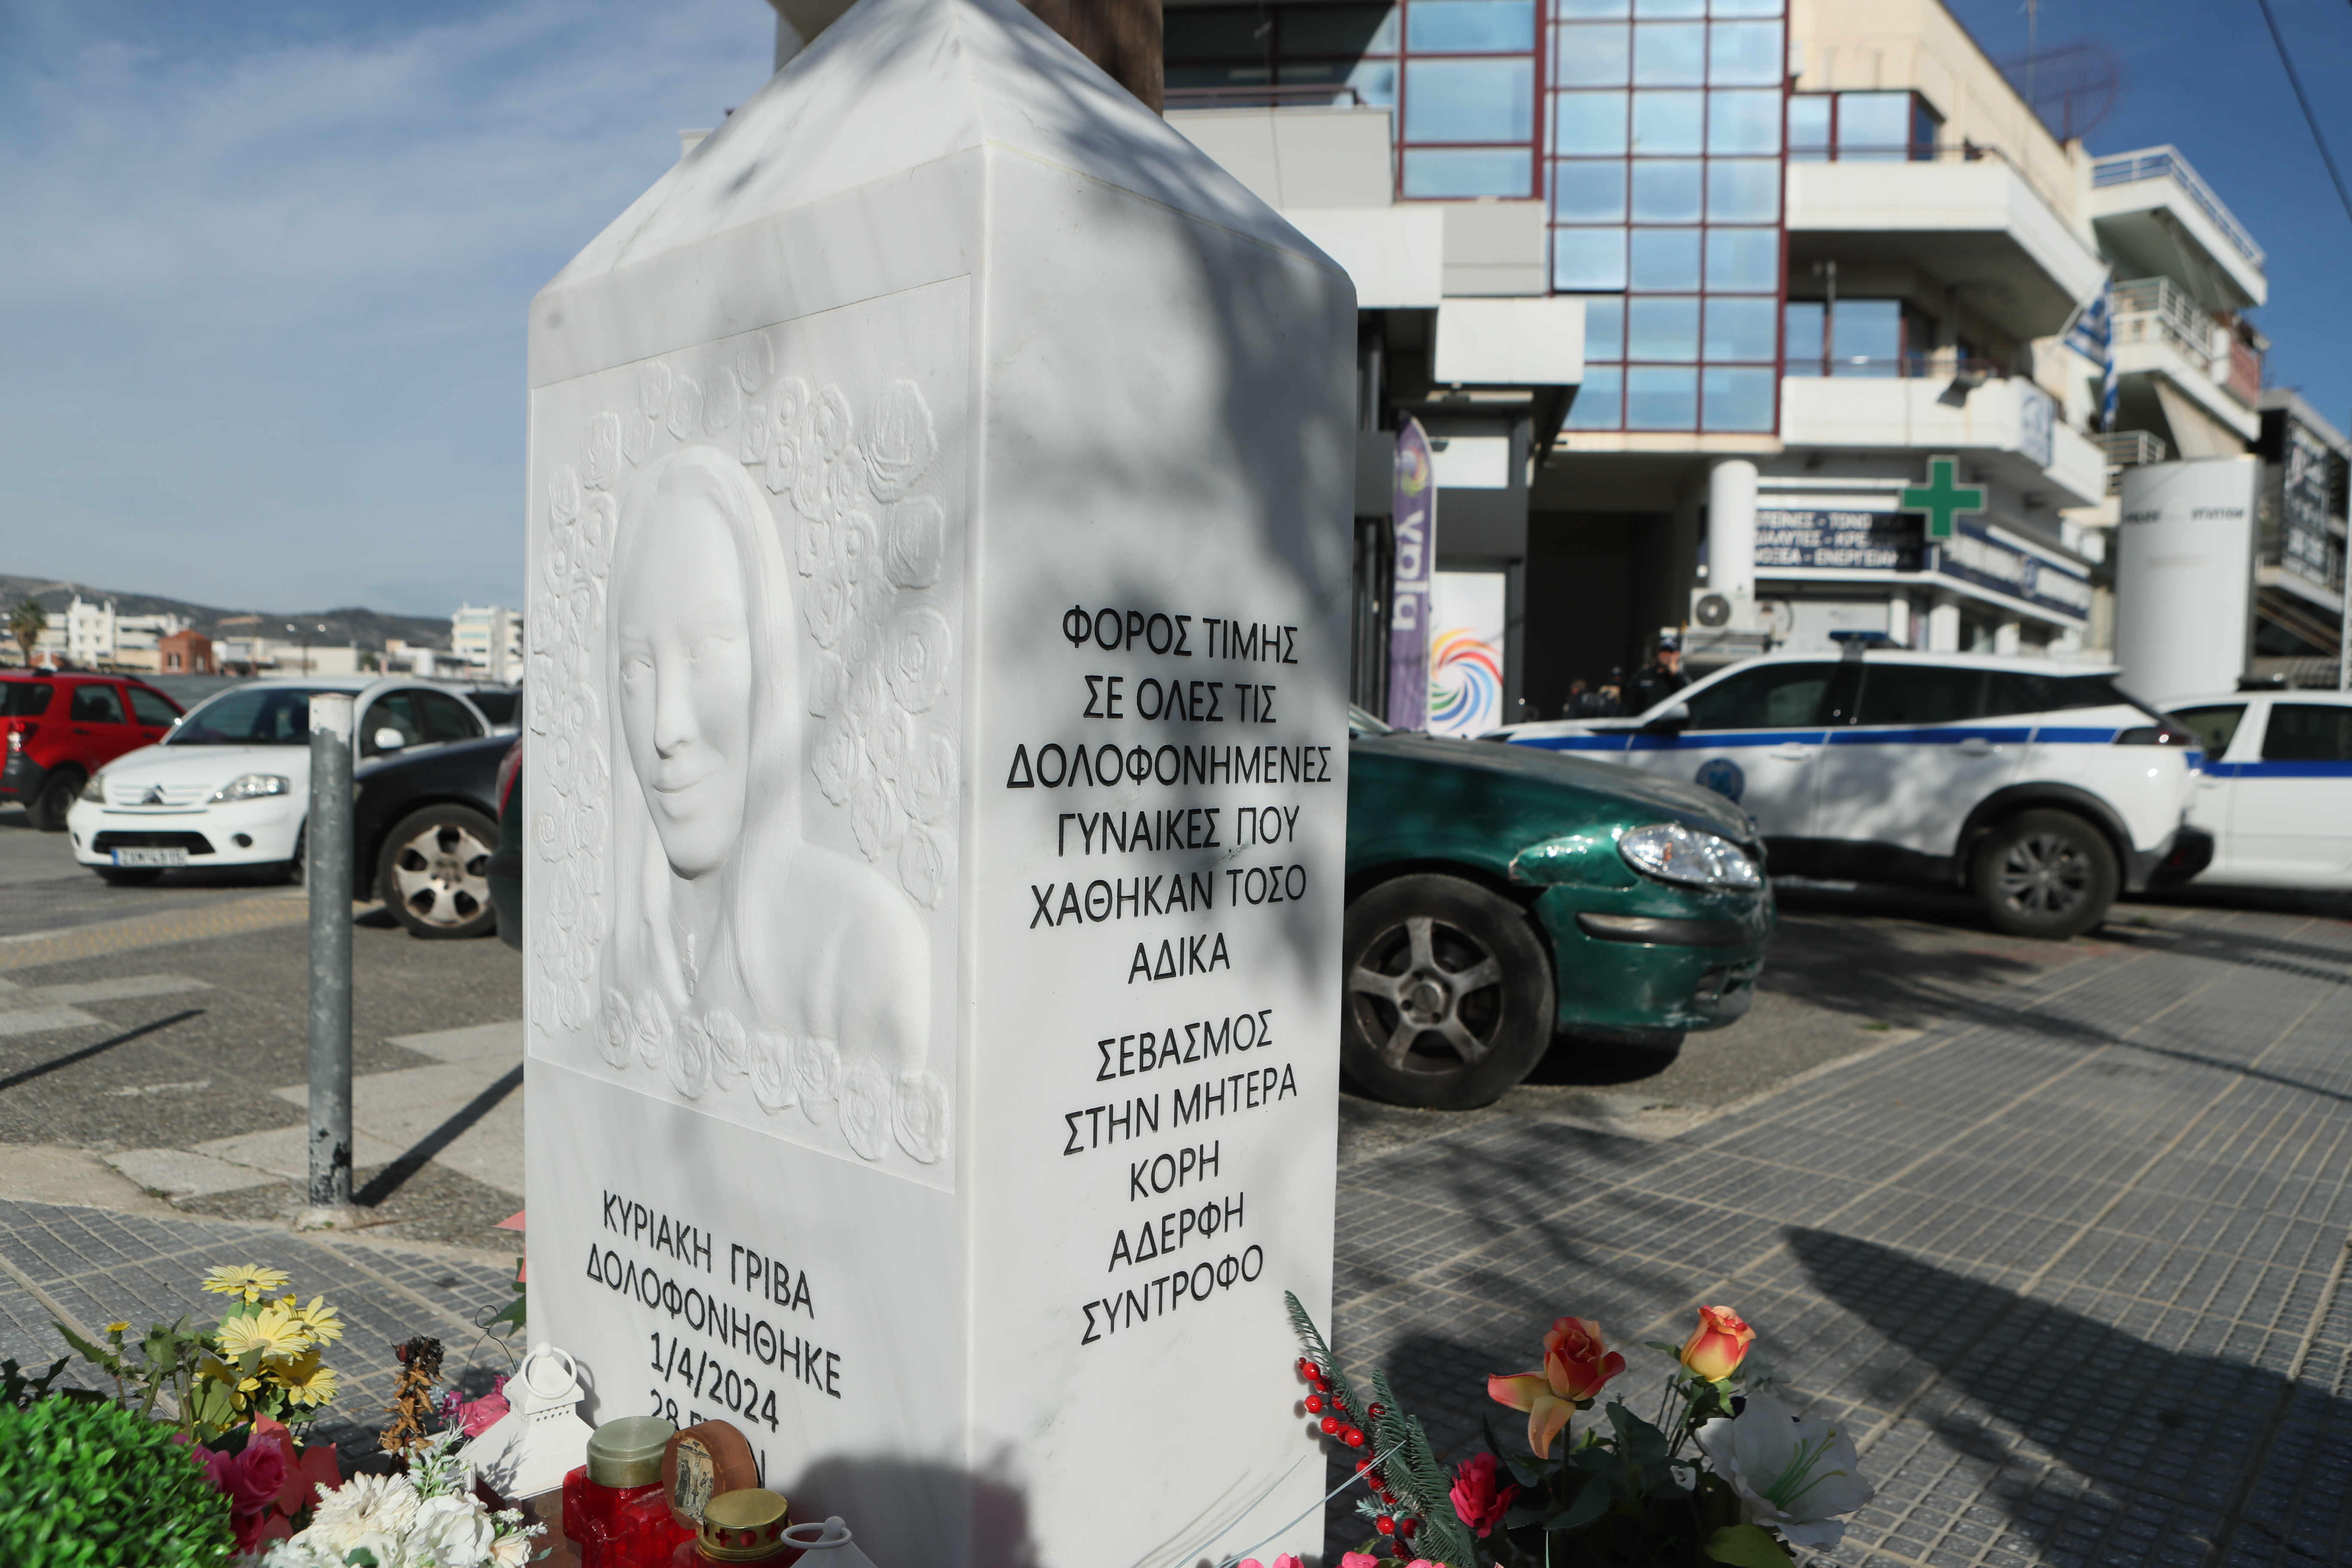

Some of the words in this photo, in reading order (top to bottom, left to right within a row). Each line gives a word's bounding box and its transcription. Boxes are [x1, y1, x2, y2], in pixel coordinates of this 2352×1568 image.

[1063, 605, 1191, 656] ΦΟΡΟΣ
[1203, 618, 1298, 664] ΤΙΜΗΣ
[1083, 675, 1123, 719] ΣΕ
[1137, 678, 1223, 722] ΟΛΕΣ
[1235, 684, 1276, 723] ΤΙΣ
[1007, 743, 1331, 788] ΔΟΛΟΦΟΝΗΜΕΝΕΣ
[1059, 808, 1220, 857] ΓΥΝΑΙΚΕΣ
[1237, 805, 1299, 845] ΠΟΥ
[1030, 871, 1213, 929] ΧΑΘΗΚΑΝ
[1226, 864, 1306, 906] ΤΟΣΟ
[1128, 933, 1230, 984] ΑΔΙΚΑ
[1096, 1010, 1272, 1081] ΣΕΒΑΣΜΟΣ
[1064, 1094, 1158, 1156] ΣΤΗΝ
[1174, 1063, 1296, 1127] ΜΗΤΕΡΑ
[1131, 1140, 1219, 1201] ΚΟΡΗ
[604, 1190, 710, 1273] ΚΥΡΙΑΚΗ
[732, 1243, 814, 1319] ΓΡΙΒΑ
[1109, 1192, 1243, 1272] ΑΔΕΡΦΗ
[587, 1243, 840, 1399] ΔΟΛΟΦΟΝΗΘΗΚΕ
[1081, 1245, 1263, 1345] ΣΥΝΤΡΟΦΟ
[652, 1332, 778, 1433] 1/4/2024
